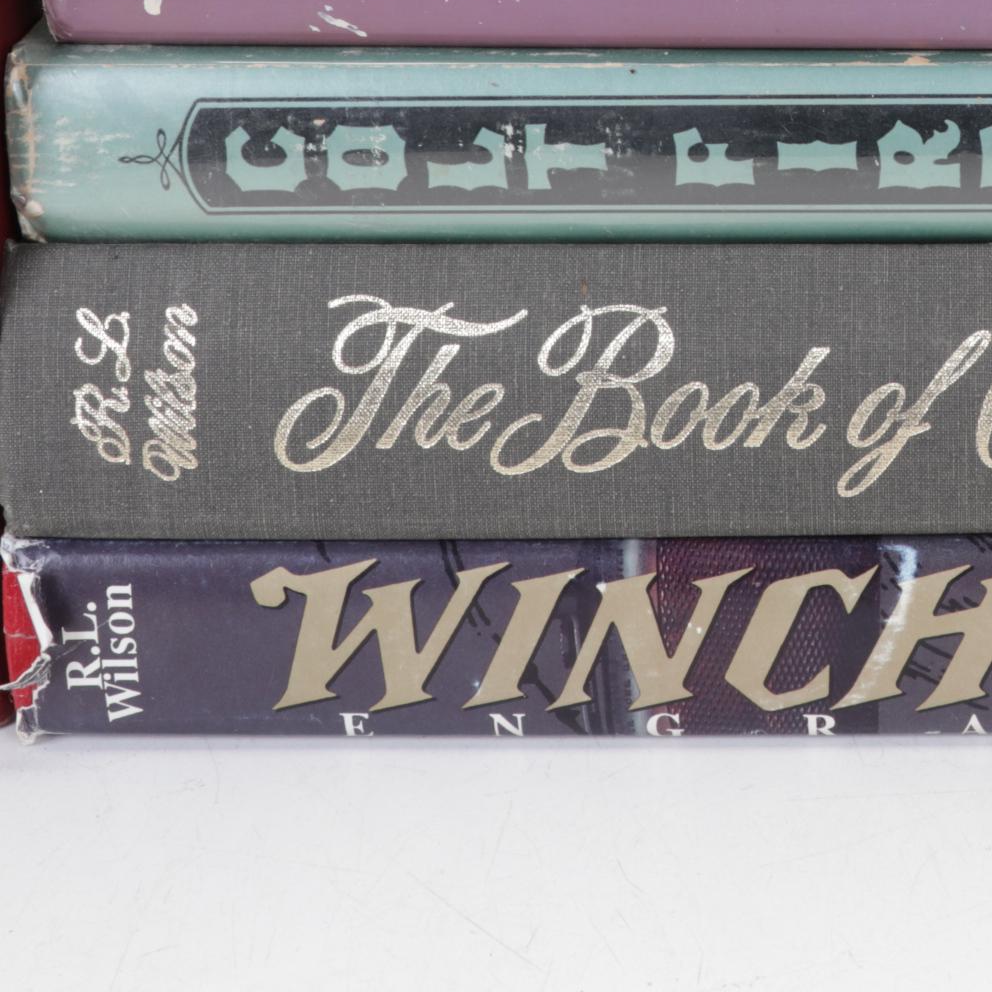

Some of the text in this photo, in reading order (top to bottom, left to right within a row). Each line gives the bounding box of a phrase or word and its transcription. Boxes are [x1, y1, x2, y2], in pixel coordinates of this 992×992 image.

[225, 123, 608, 192] COLT
[143, 304, 198, 481] Wilson
[274, 294, 530, 475] The
[488, 304, 830, 475] Book
[837, 328, 991, 498] of
[100, 583, 145, 723] Wilson
